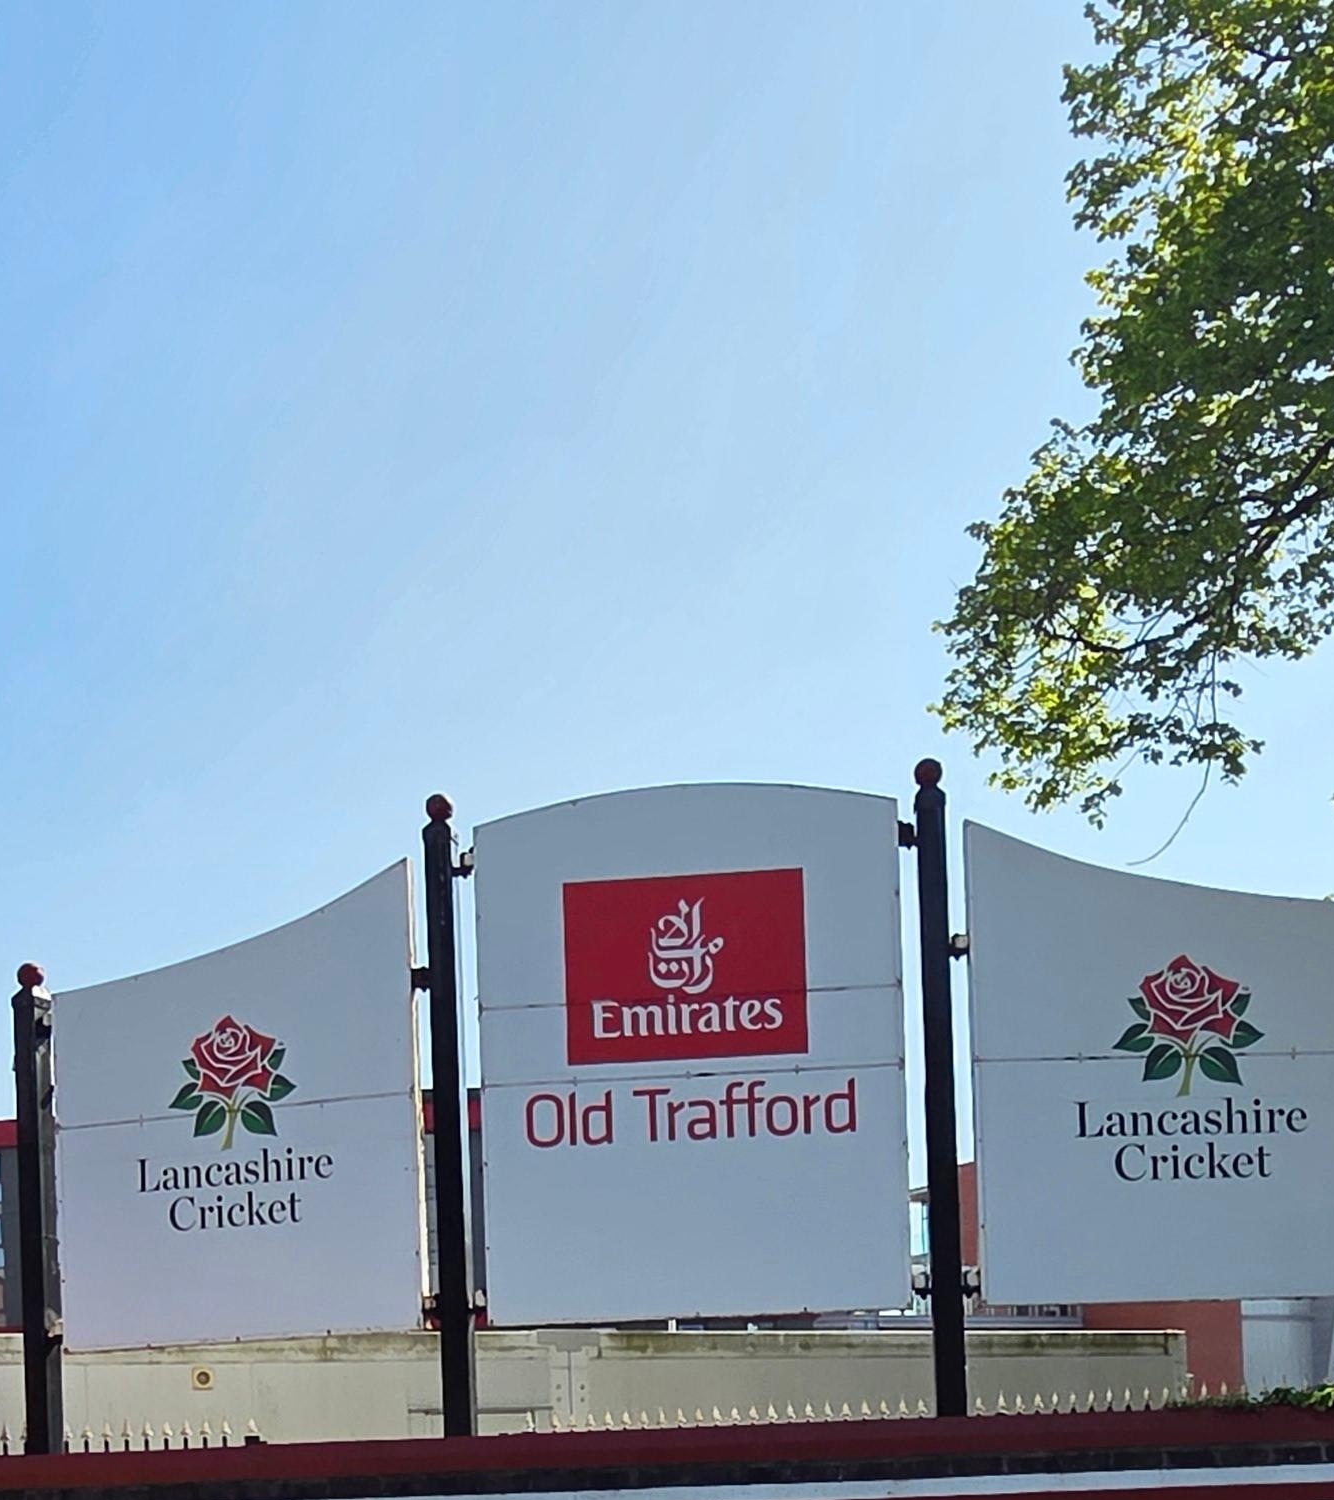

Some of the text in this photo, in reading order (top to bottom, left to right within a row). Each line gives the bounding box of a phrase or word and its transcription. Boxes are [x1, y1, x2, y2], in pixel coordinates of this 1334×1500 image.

[591, 994, 783, 1039] Emirates
[524, 1076, 858, 1148] Old Trafford
[1072, 1097, 1309, 1138] Lancashire
[137, 1147, 334, 1193] Lancashire
[1114, 1142, 1273, 1181] Cricket
[168, 1190, 302, 1232] Cricket
